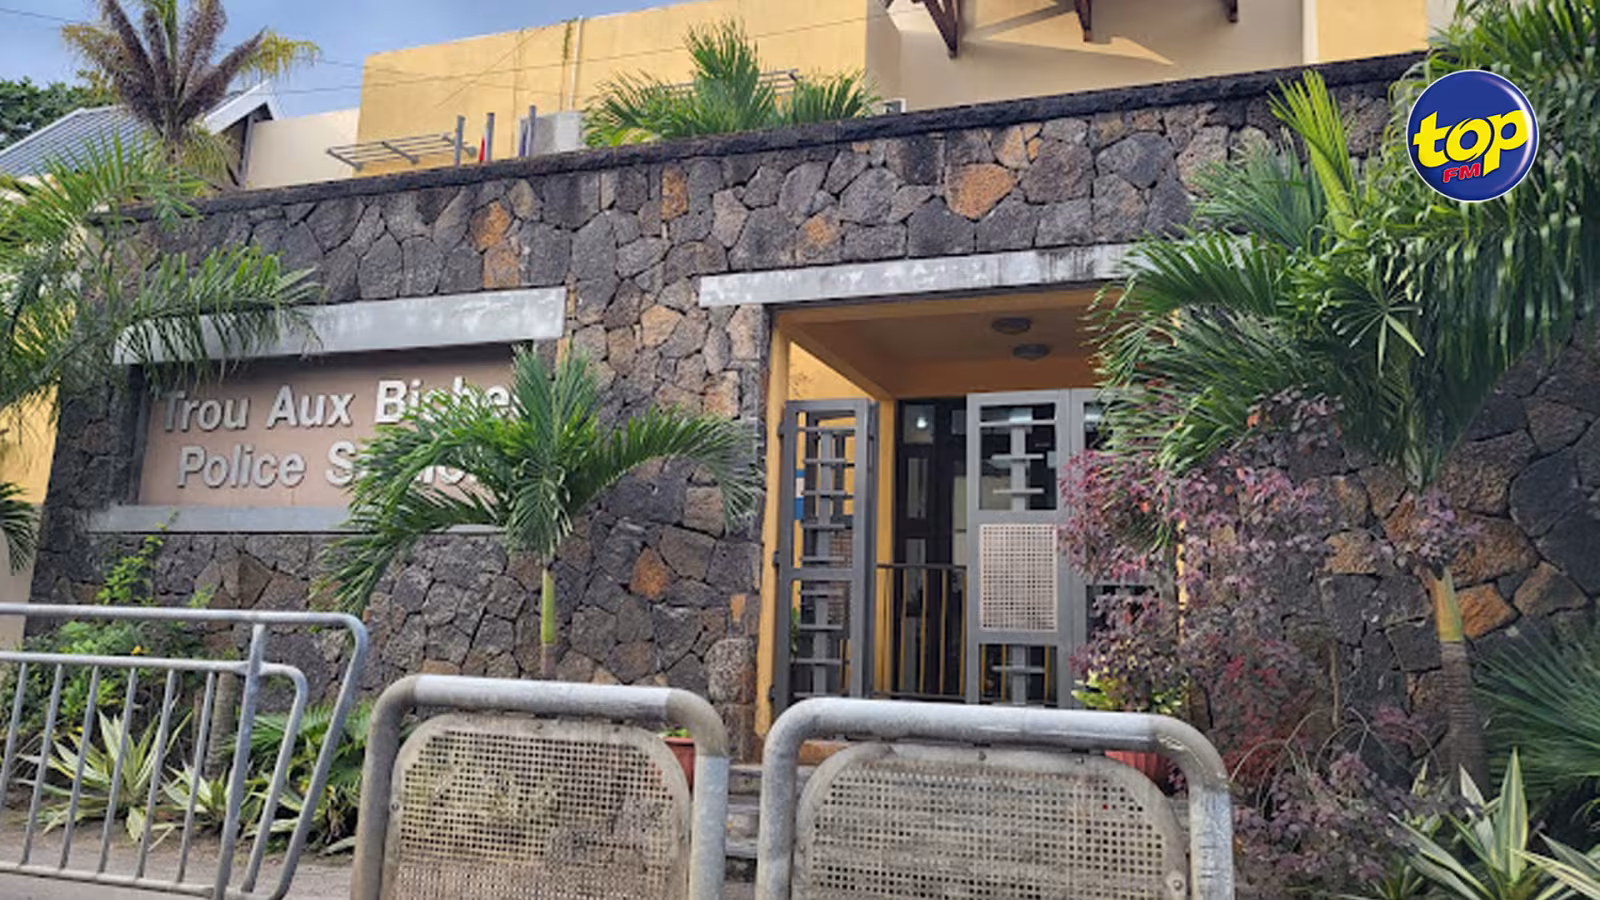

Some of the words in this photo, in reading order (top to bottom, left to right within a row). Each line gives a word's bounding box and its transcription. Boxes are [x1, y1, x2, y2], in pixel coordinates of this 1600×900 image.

[163, 391, 250, 432] Trou
[266, 385, 354, 428] Aux
[176, 445, 306, 488] Police
